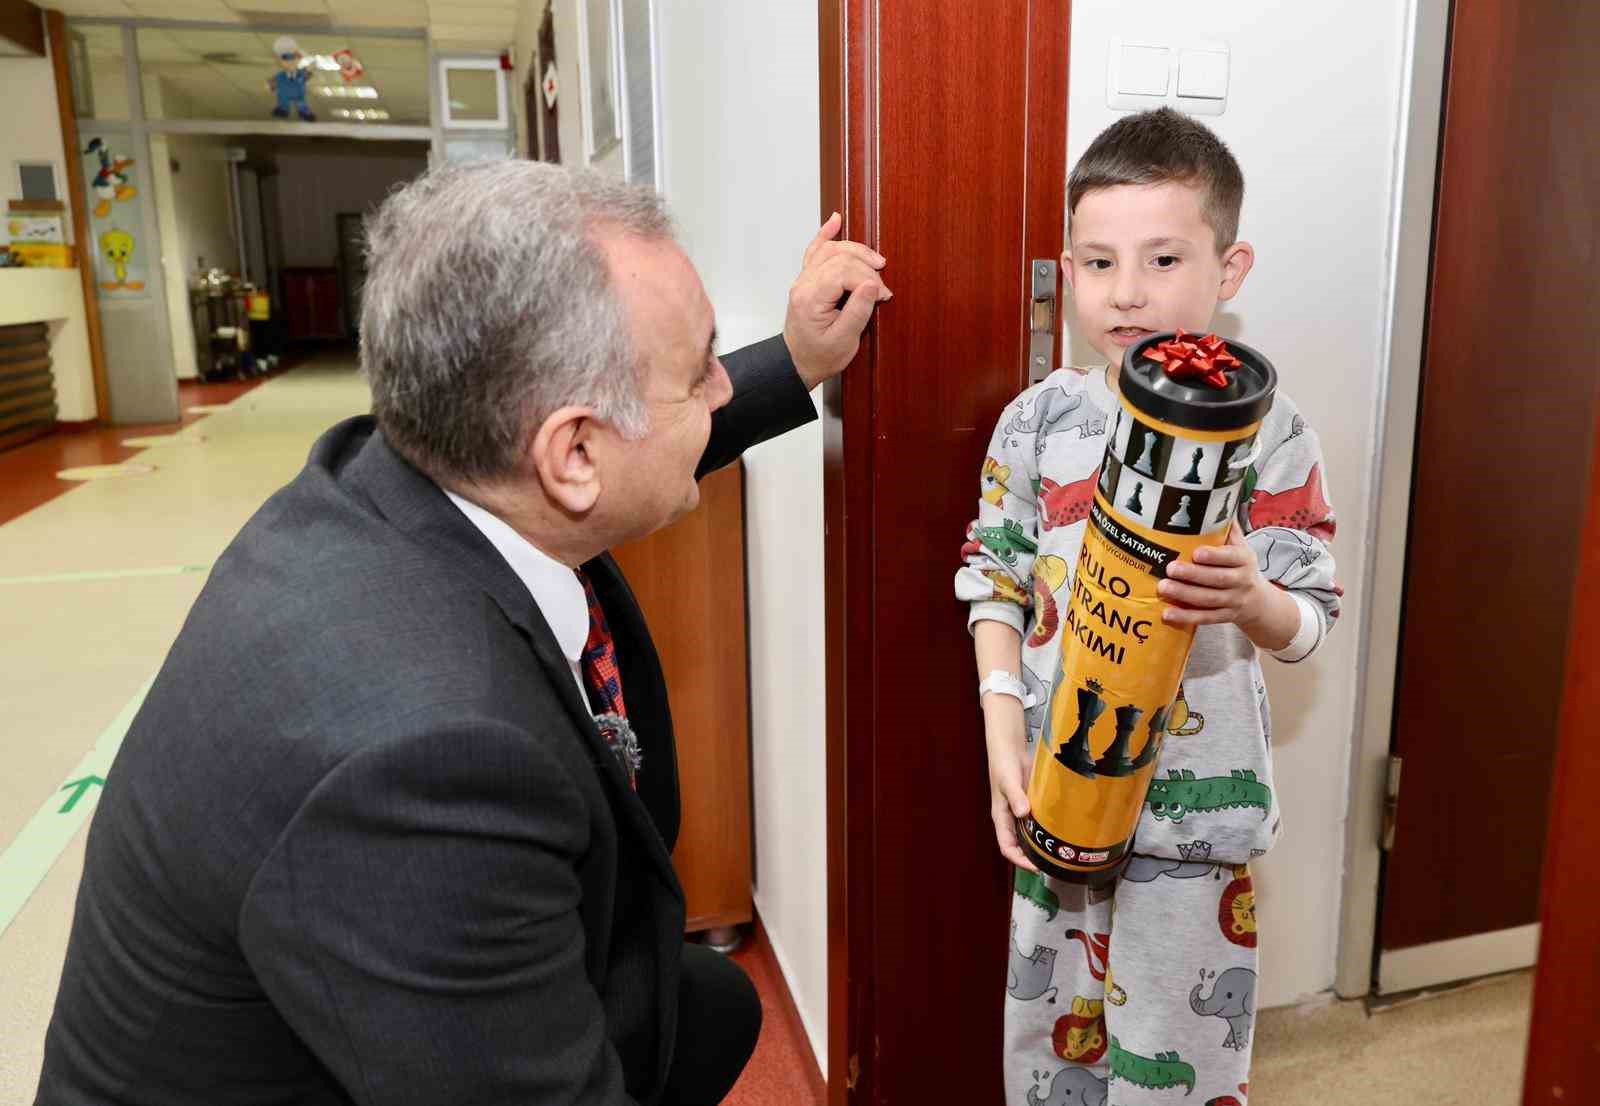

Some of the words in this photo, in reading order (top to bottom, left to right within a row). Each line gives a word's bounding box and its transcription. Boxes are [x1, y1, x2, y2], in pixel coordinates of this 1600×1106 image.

[1101, 515, 1119, 538] ÖZEL
[1120, 532, 1166, 564] SATRANÇ
[1080, 543, 1130, 598] RULO
[1066, 608, 1125, 664] AKIMI
[1073, 577, 1152, 644] TRANÇ
